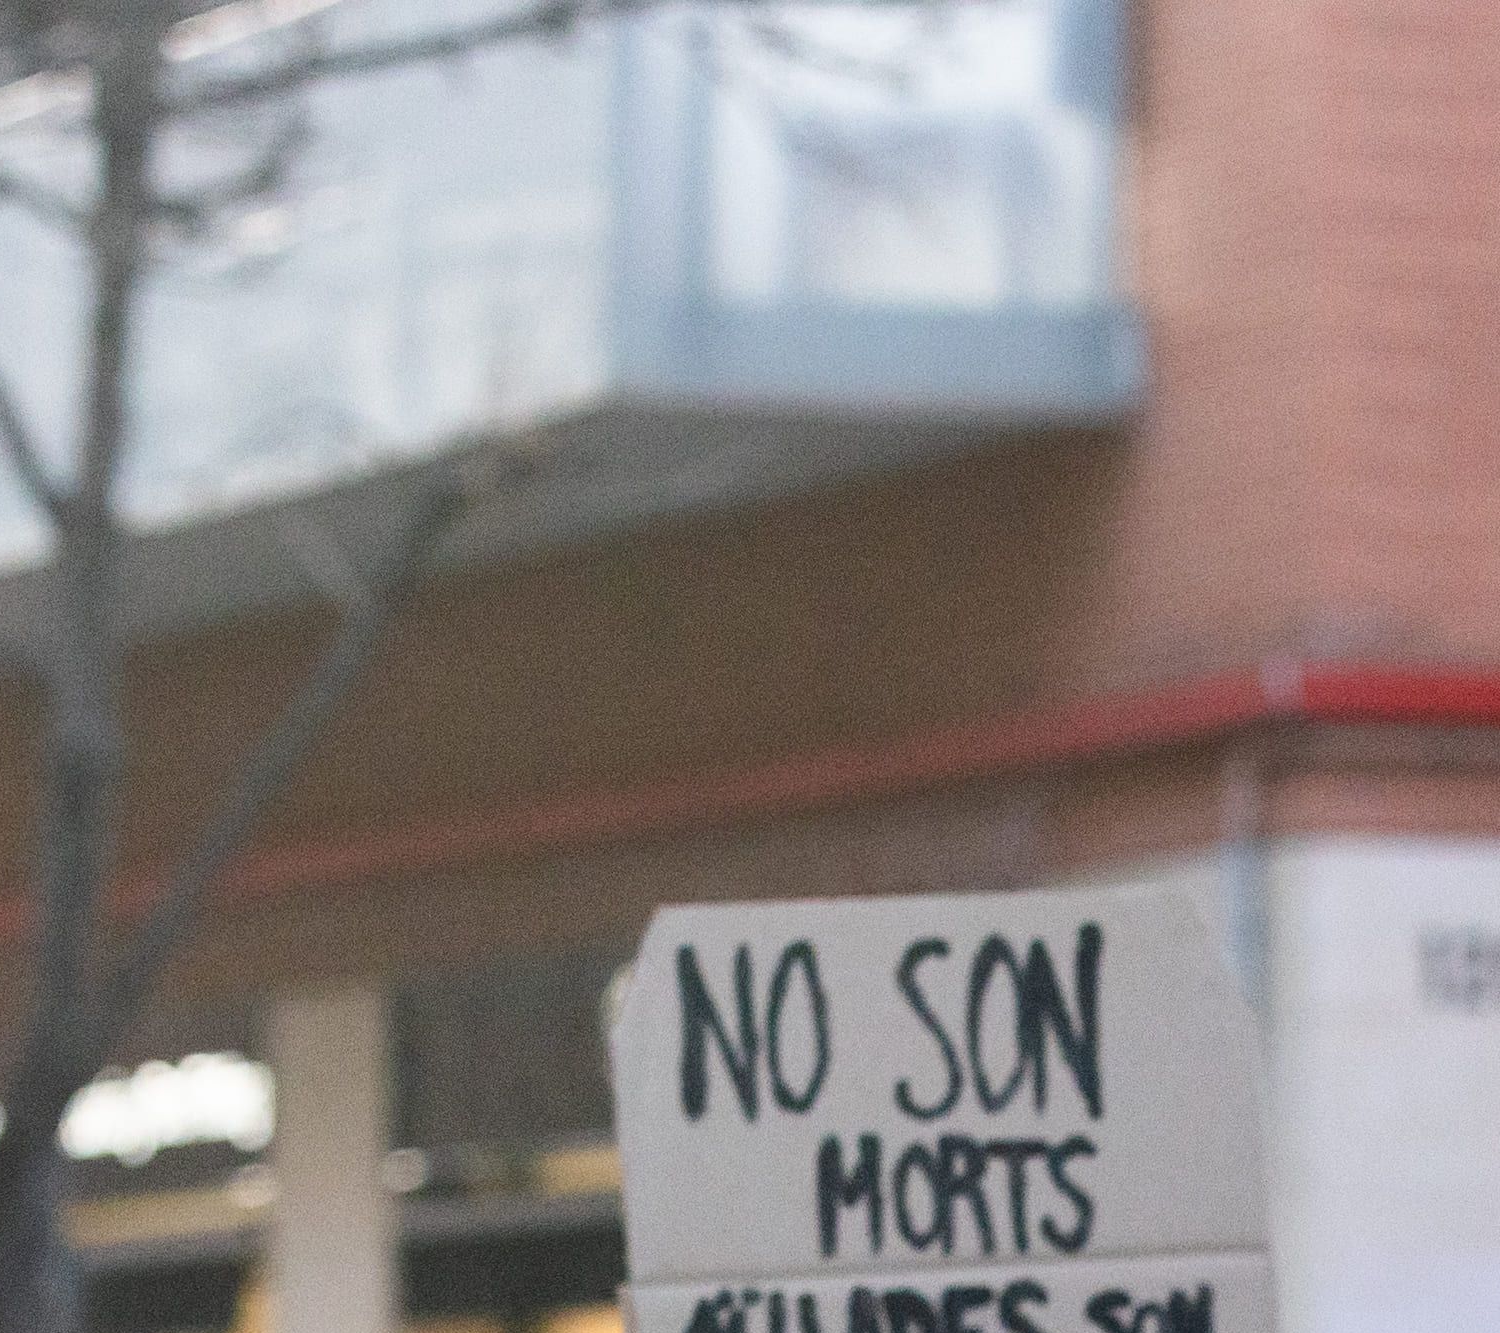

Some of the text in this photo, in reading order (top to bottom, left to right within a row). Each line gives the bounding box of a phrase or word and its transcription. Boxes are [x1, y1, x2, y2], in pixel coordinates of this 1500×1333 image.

[676, 921, 1104, 1122] NO SON
[817, 1130, 1098, 1259] MORTS
